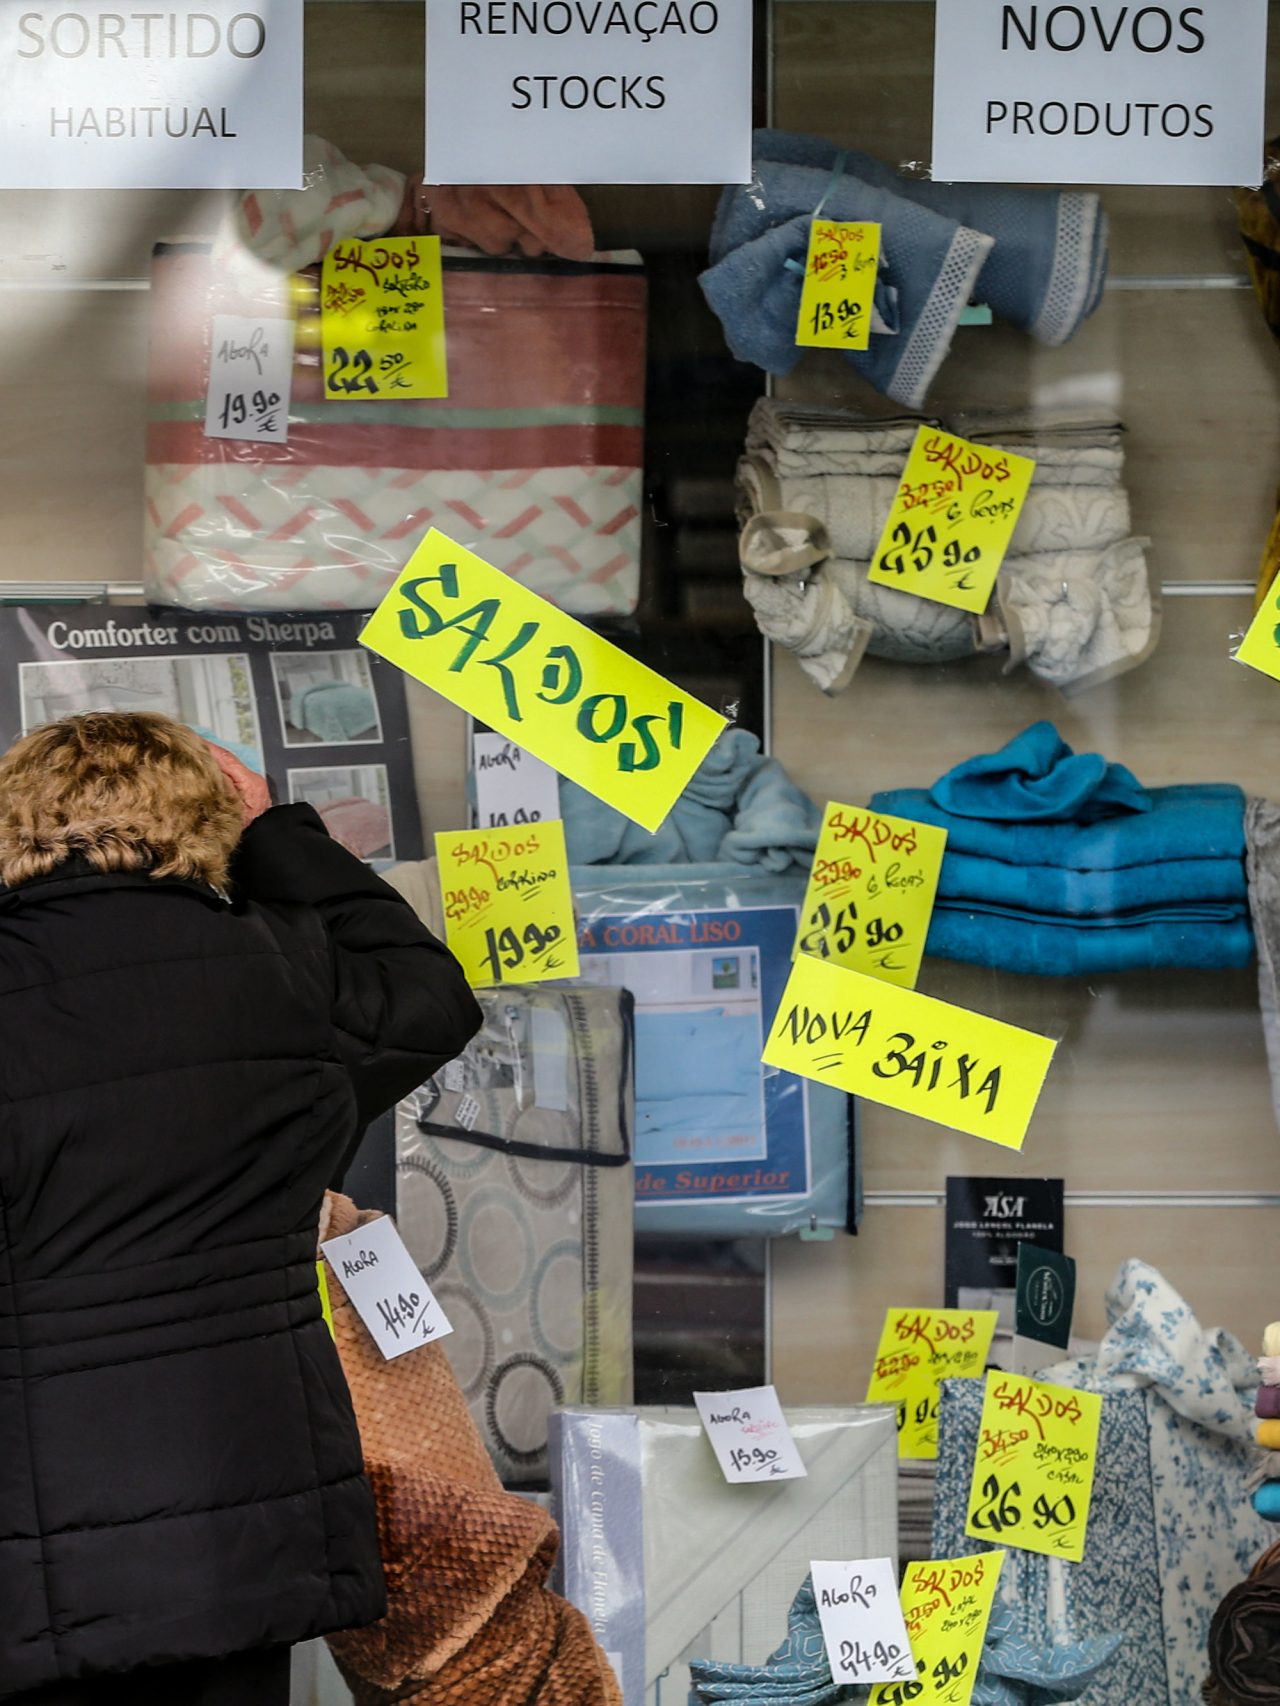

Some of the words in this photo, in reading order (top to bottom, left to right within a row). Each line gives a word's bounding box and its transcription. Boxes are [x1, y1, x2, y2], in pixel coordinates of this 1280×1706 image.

[17, 12, 267, 60] SORTIDO
[1001, 5, 1205, 54] NOVOS
[510, 74, 667, 111] STOCKS
[50, 106, 237, 139] HABITUAL
[985, 101, 1215, 139] PRODUTOS
[333, 241, 420, 287] SALDOS
[924, 436, 1011, 492] SALDOS
[47, 619, 178, 650] Comforter
[187, 623, 241, 644] com
[248, 618, 336, 646] Sherpa
[398, 564, 683, 773] SALDOS
[479, 740, 521, 770] AGORA
[828, 812, 917, 864] SALDOS
[451, 835, 541, 882] SALDOS
[603, 923, 684, 946] CORAL
[690, 920, 741, 942] LISO
[778, 1004, 873, 1046] NOVA
[675, 1169, 789, 1191] Superior
[342, 1250, 379, 1278] AGORA
[896, 1313, 975, 1354] SALDOS
[710, 1407, 751, 1424] AGORA
[993, 1381, 1082, 1440] SALDOS
[588, 1423, 603, 1460] Jogo
[591, 1465, 605, 1485] de
[591, 1490, 606, 1539] Cama
[593, 1543, 607, 1567] de
[821, 1575, 877, 1609] AGORA
[912, 1558, 984, 1607] SALDOS
[593, 1572, 609, 1634] Flanela
